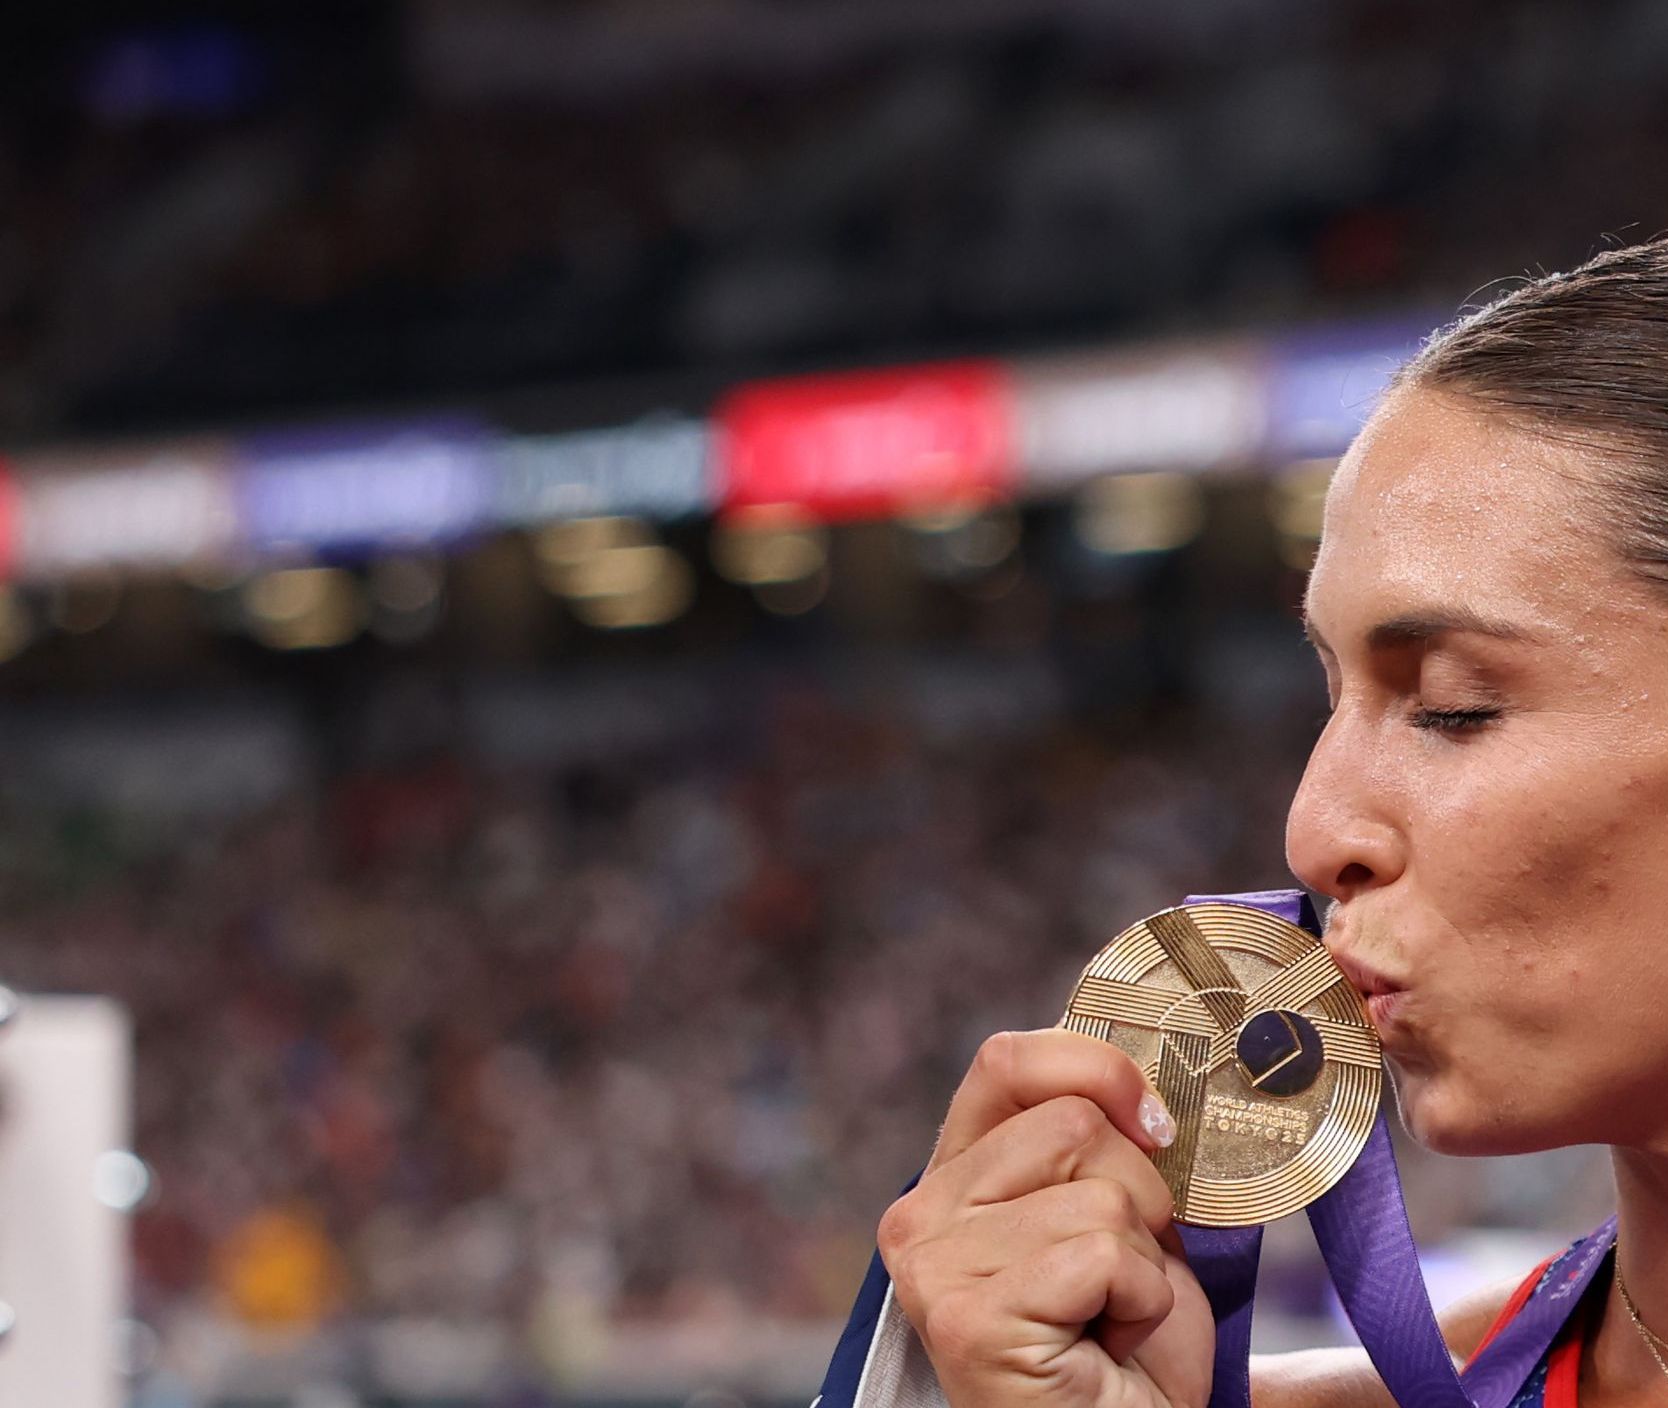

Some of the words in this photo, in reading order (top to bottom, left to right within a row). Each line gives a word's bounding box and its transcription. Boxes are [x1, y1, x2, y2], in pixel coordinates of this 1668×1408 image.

[1204, 1105, 1307, 1132] CHAMPIONSHIPS
[1207, 1095, 1248, 1110] WORLD
[1249, 1102, 1308, 1121] ATHLETICS
